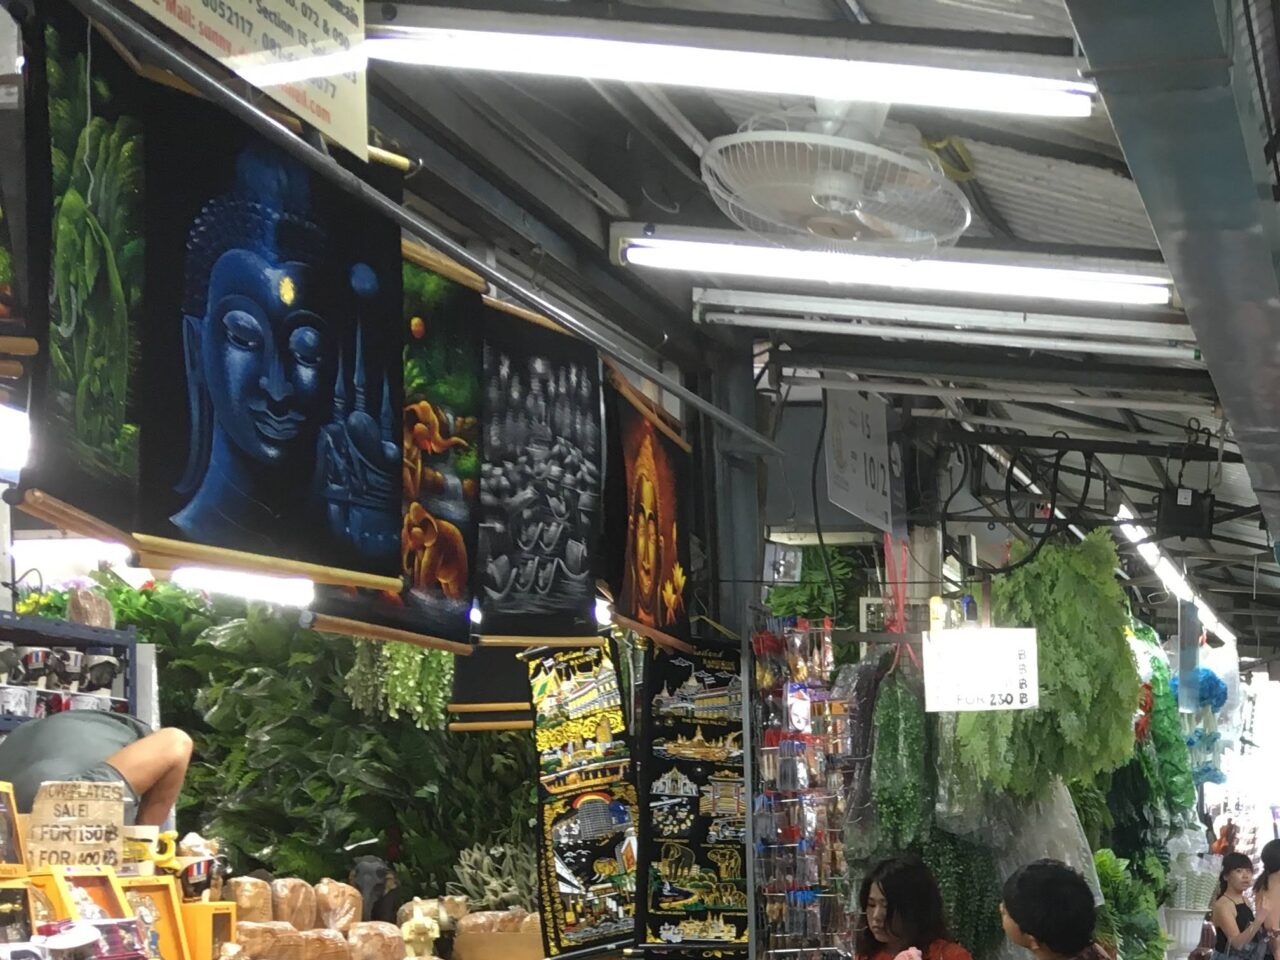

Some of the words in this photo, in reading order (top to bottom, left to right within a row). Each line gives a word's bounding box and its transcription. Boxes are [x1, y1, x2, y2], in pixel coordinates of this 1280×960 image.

[255, 0, 294, 38] Section
[297, 29, 307, 47] 15
[301, 2, 319, 28] 072
[40, 824, 72, 842] FOR
[39, 850, 71, 867] FOR
